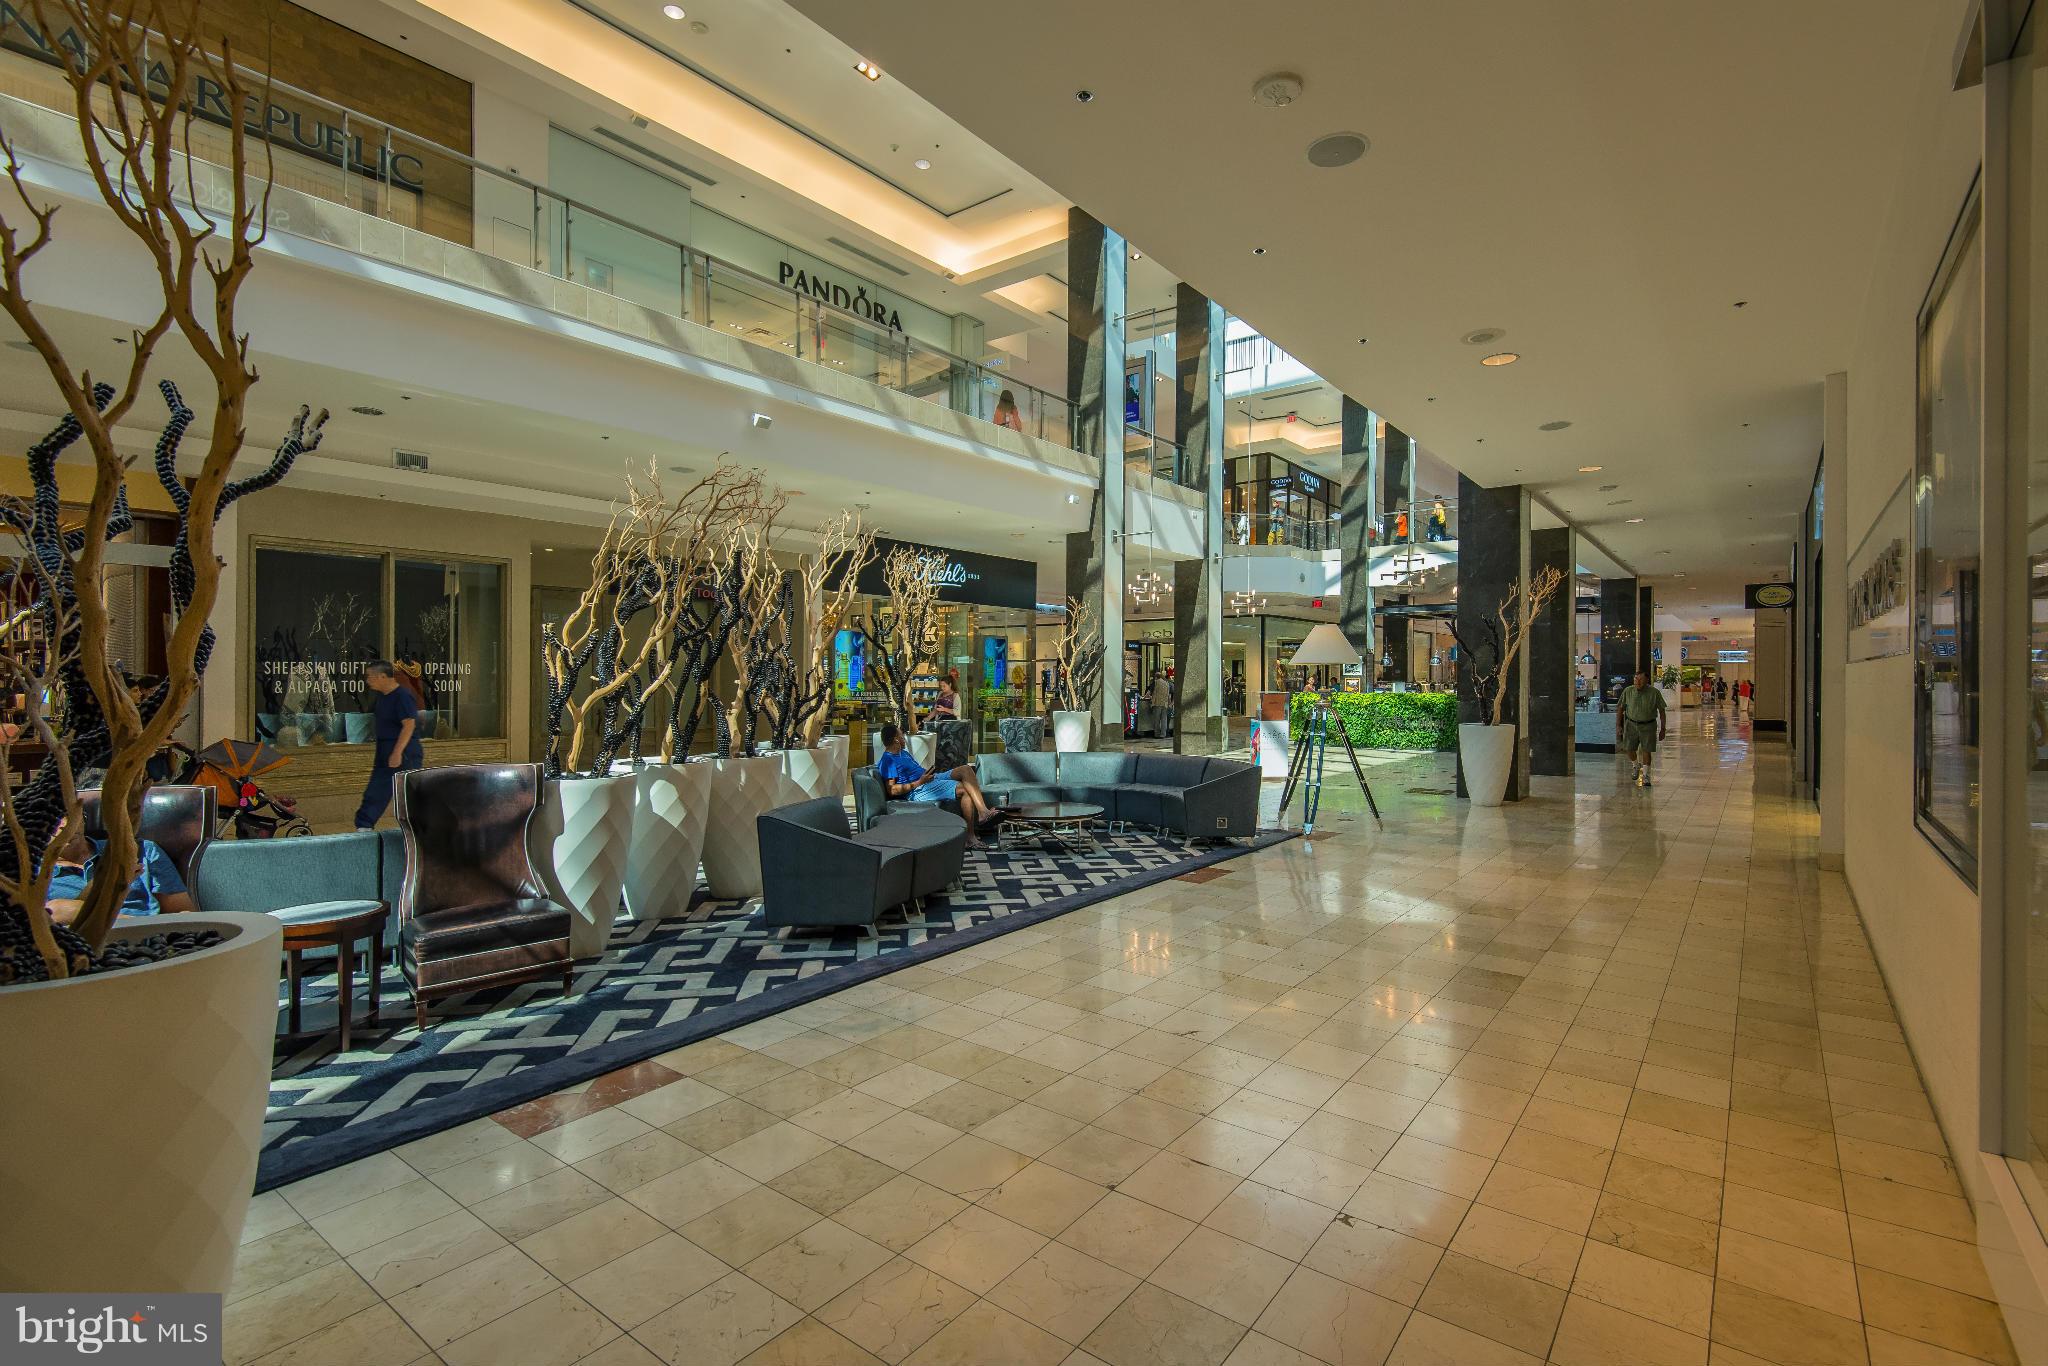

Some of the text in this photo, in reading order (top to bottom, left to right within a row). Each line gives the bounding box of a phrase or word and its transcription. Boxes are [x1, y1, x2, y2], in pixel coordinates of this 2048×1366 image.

[196, 75, 424, 186] REPUBLIC
[779, 261, 903, 332] PANDORA
[264, 661, 472, 676] SHEEPSKIN GIFT OPENING
[274, 680, 462, 694] & ALPACA TOO SOON
